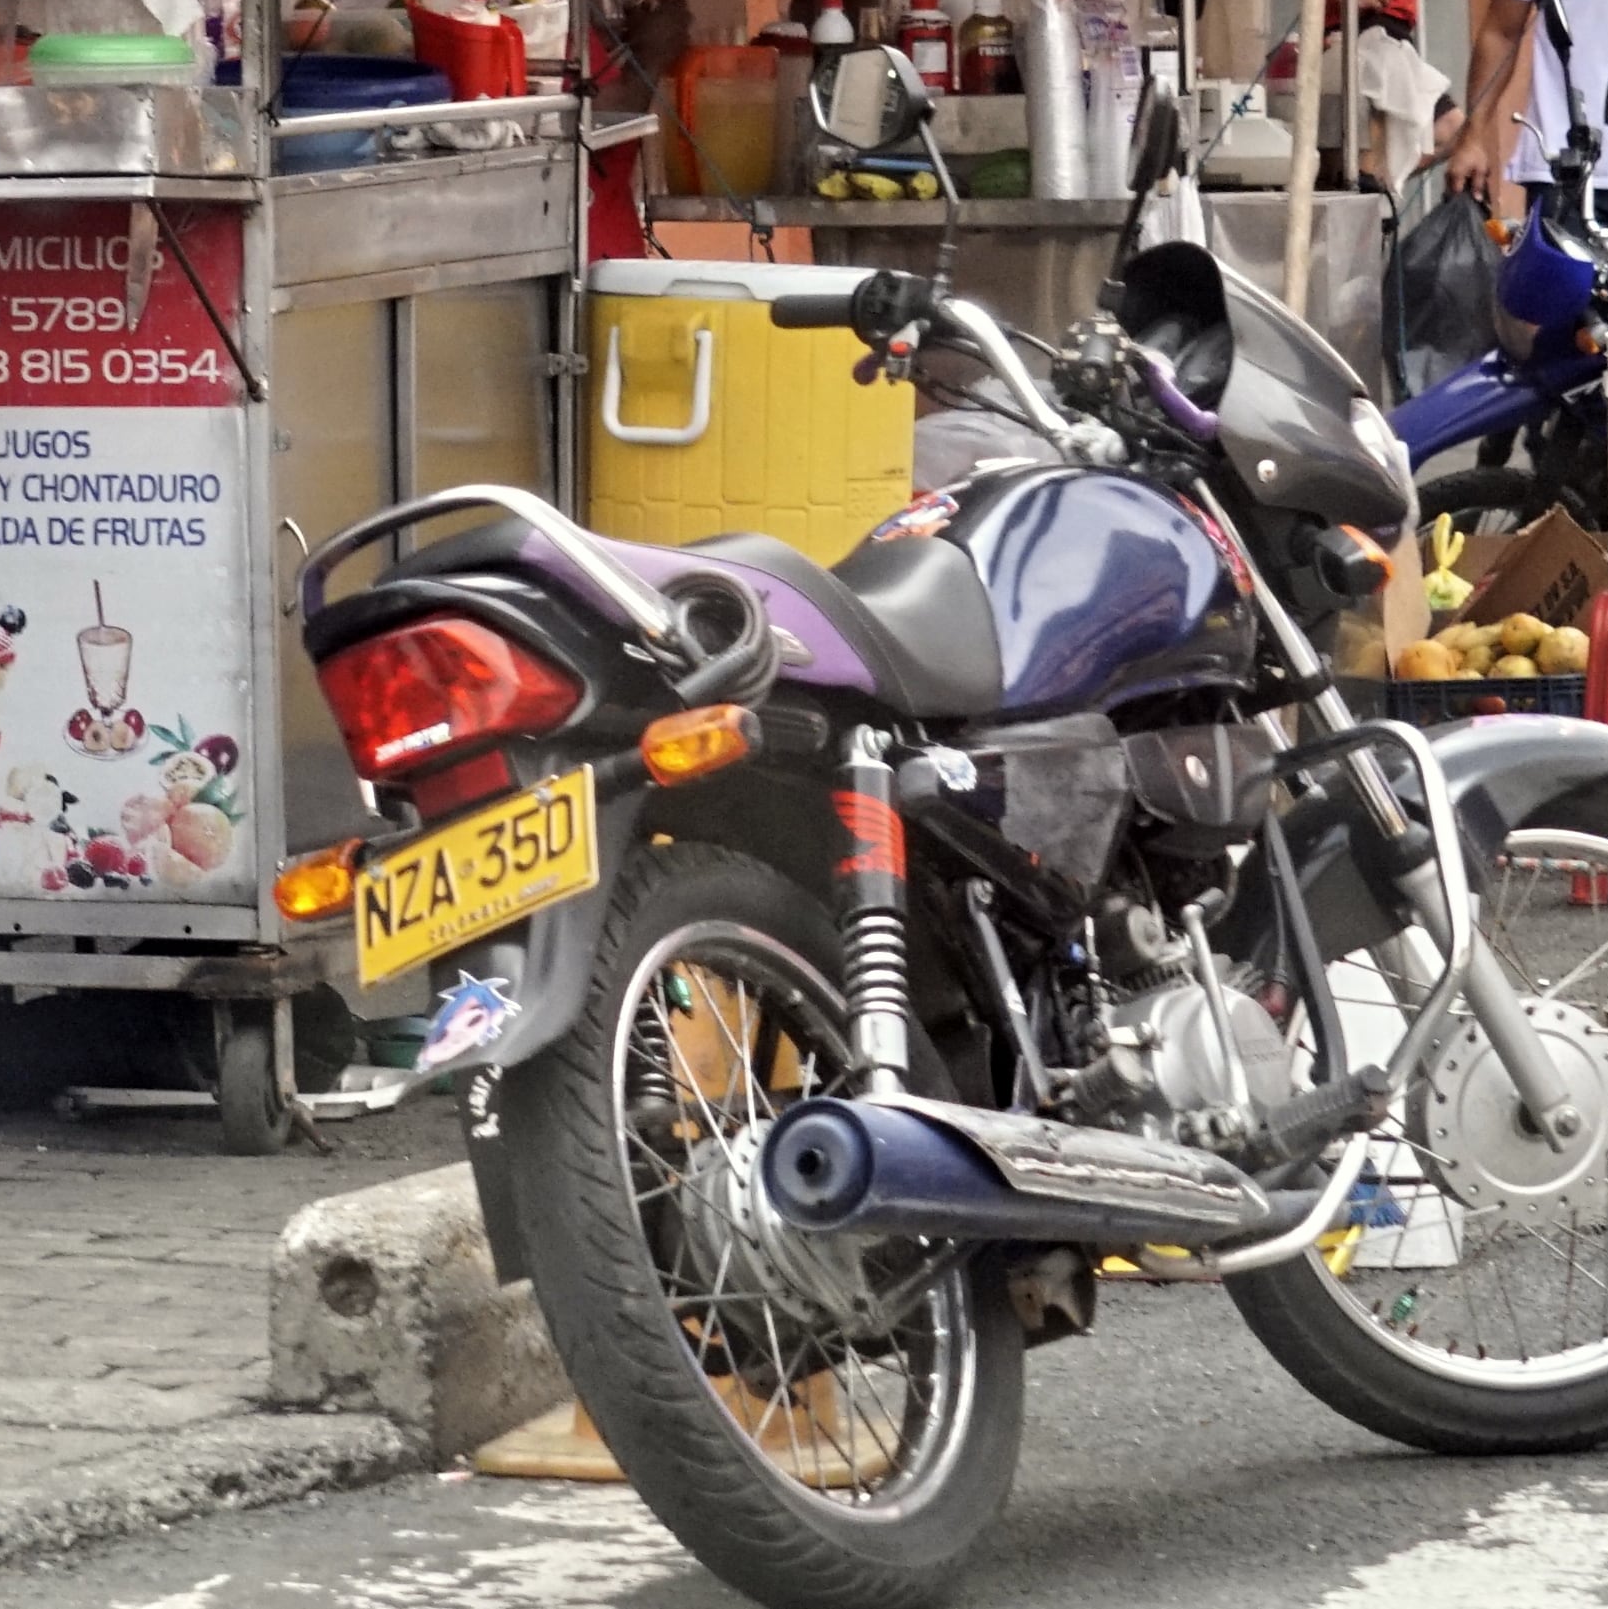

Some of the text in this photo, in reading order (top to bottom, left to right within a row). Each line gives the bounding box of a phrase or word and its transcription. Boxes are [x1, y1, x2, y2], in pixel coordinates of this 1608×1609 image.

[10, 296, 127, 333] 5789
[20, 348, 92, 384] 815
[101, 348, 222, 385] 0354
[22, 473, 222, 503] CHONTADURO
[48, 517, 86, 546] DE
[93, 518, 207, 547] FRUTAS
